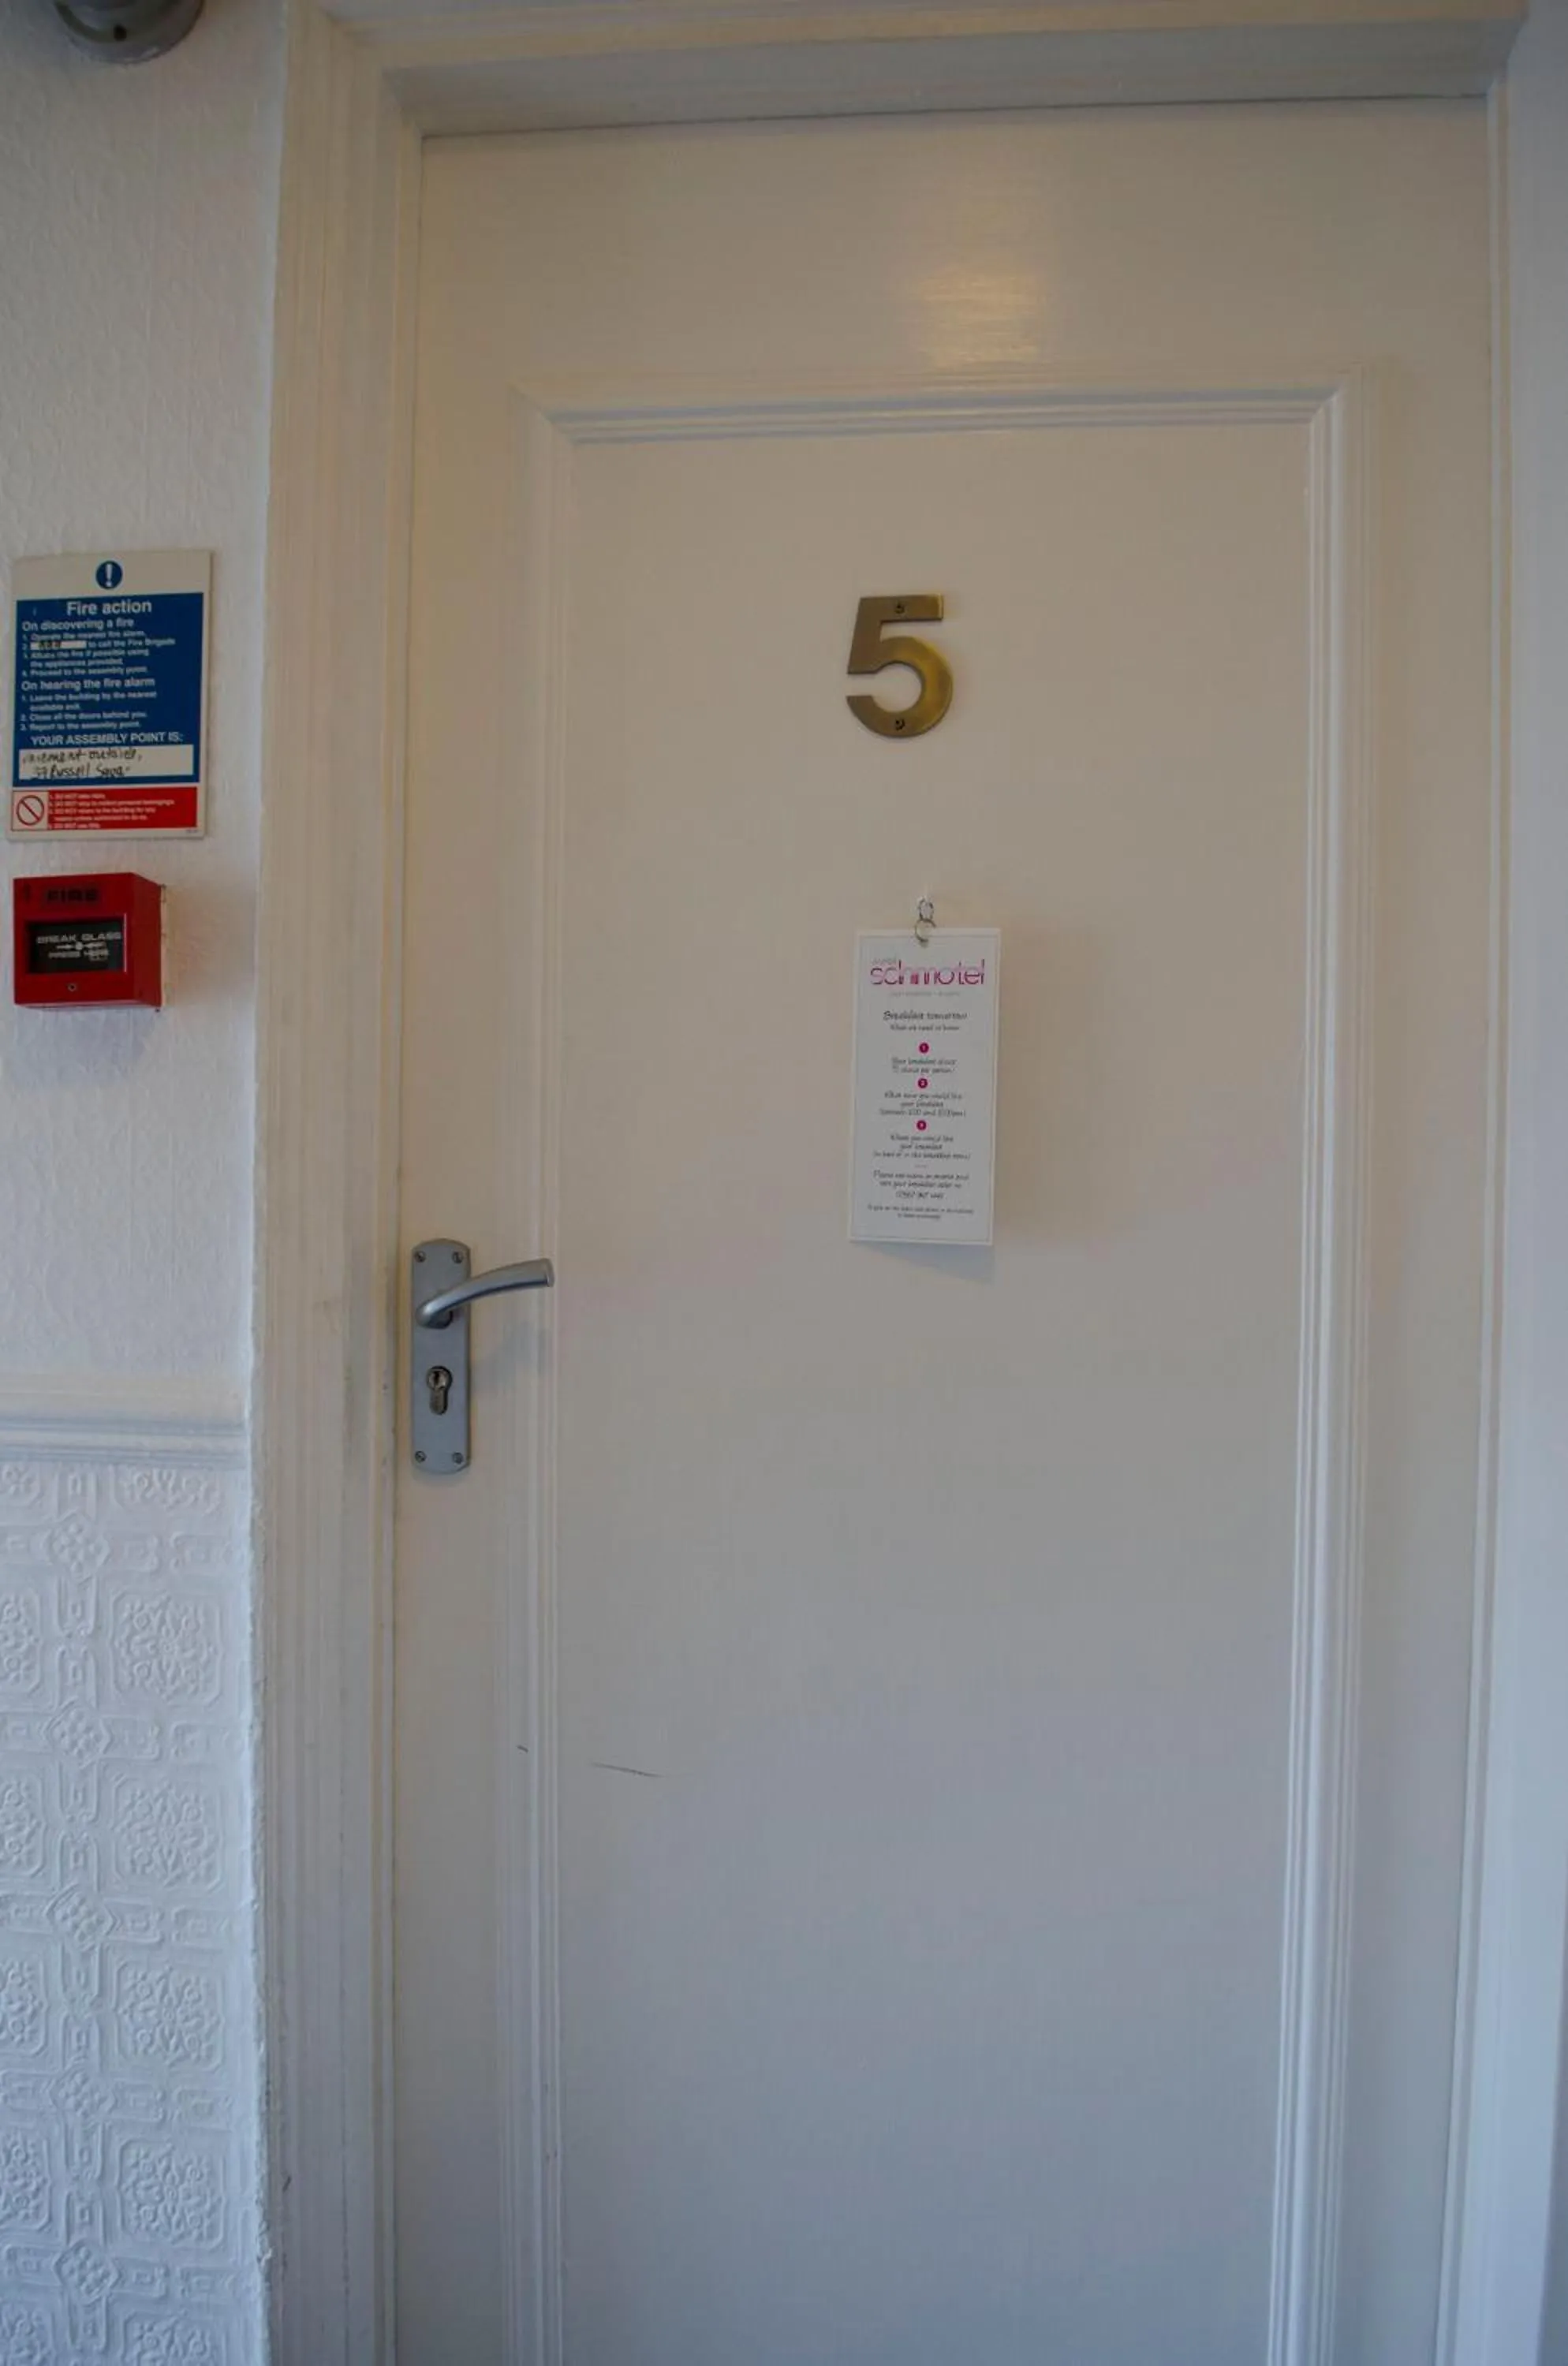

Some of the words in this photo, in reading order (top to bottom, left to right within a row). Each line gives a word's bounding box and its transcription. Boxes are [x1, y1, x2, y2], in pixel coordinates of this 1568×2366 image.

[66, 602, 97, 616] Fire
[103, 599, 152, 614] action
[22, 621, 38, 632] On
[41, 619, 104, 631] discovering
[116, 618, 134, 627] fire
[846, 594, 954, 738] 5
[21, 681, 38, 691] On
[41, 680, 81, 692] hearing
[84, 679, 101, 689] the
[103, 678, 121, 687] fire
[124, 677, 155, 686] alarm
[32, 735, 65, 745] YOUR
[66, 734, 127, 744] ASSEMBLY
[130, 733, 164, 743] POINT
[168, 733, 183, 741] IS:
[47, 888, 99, 902] FIRE
[36, 935, 77, 943] BREAK
[81, 931, 121, 941] GLASS
